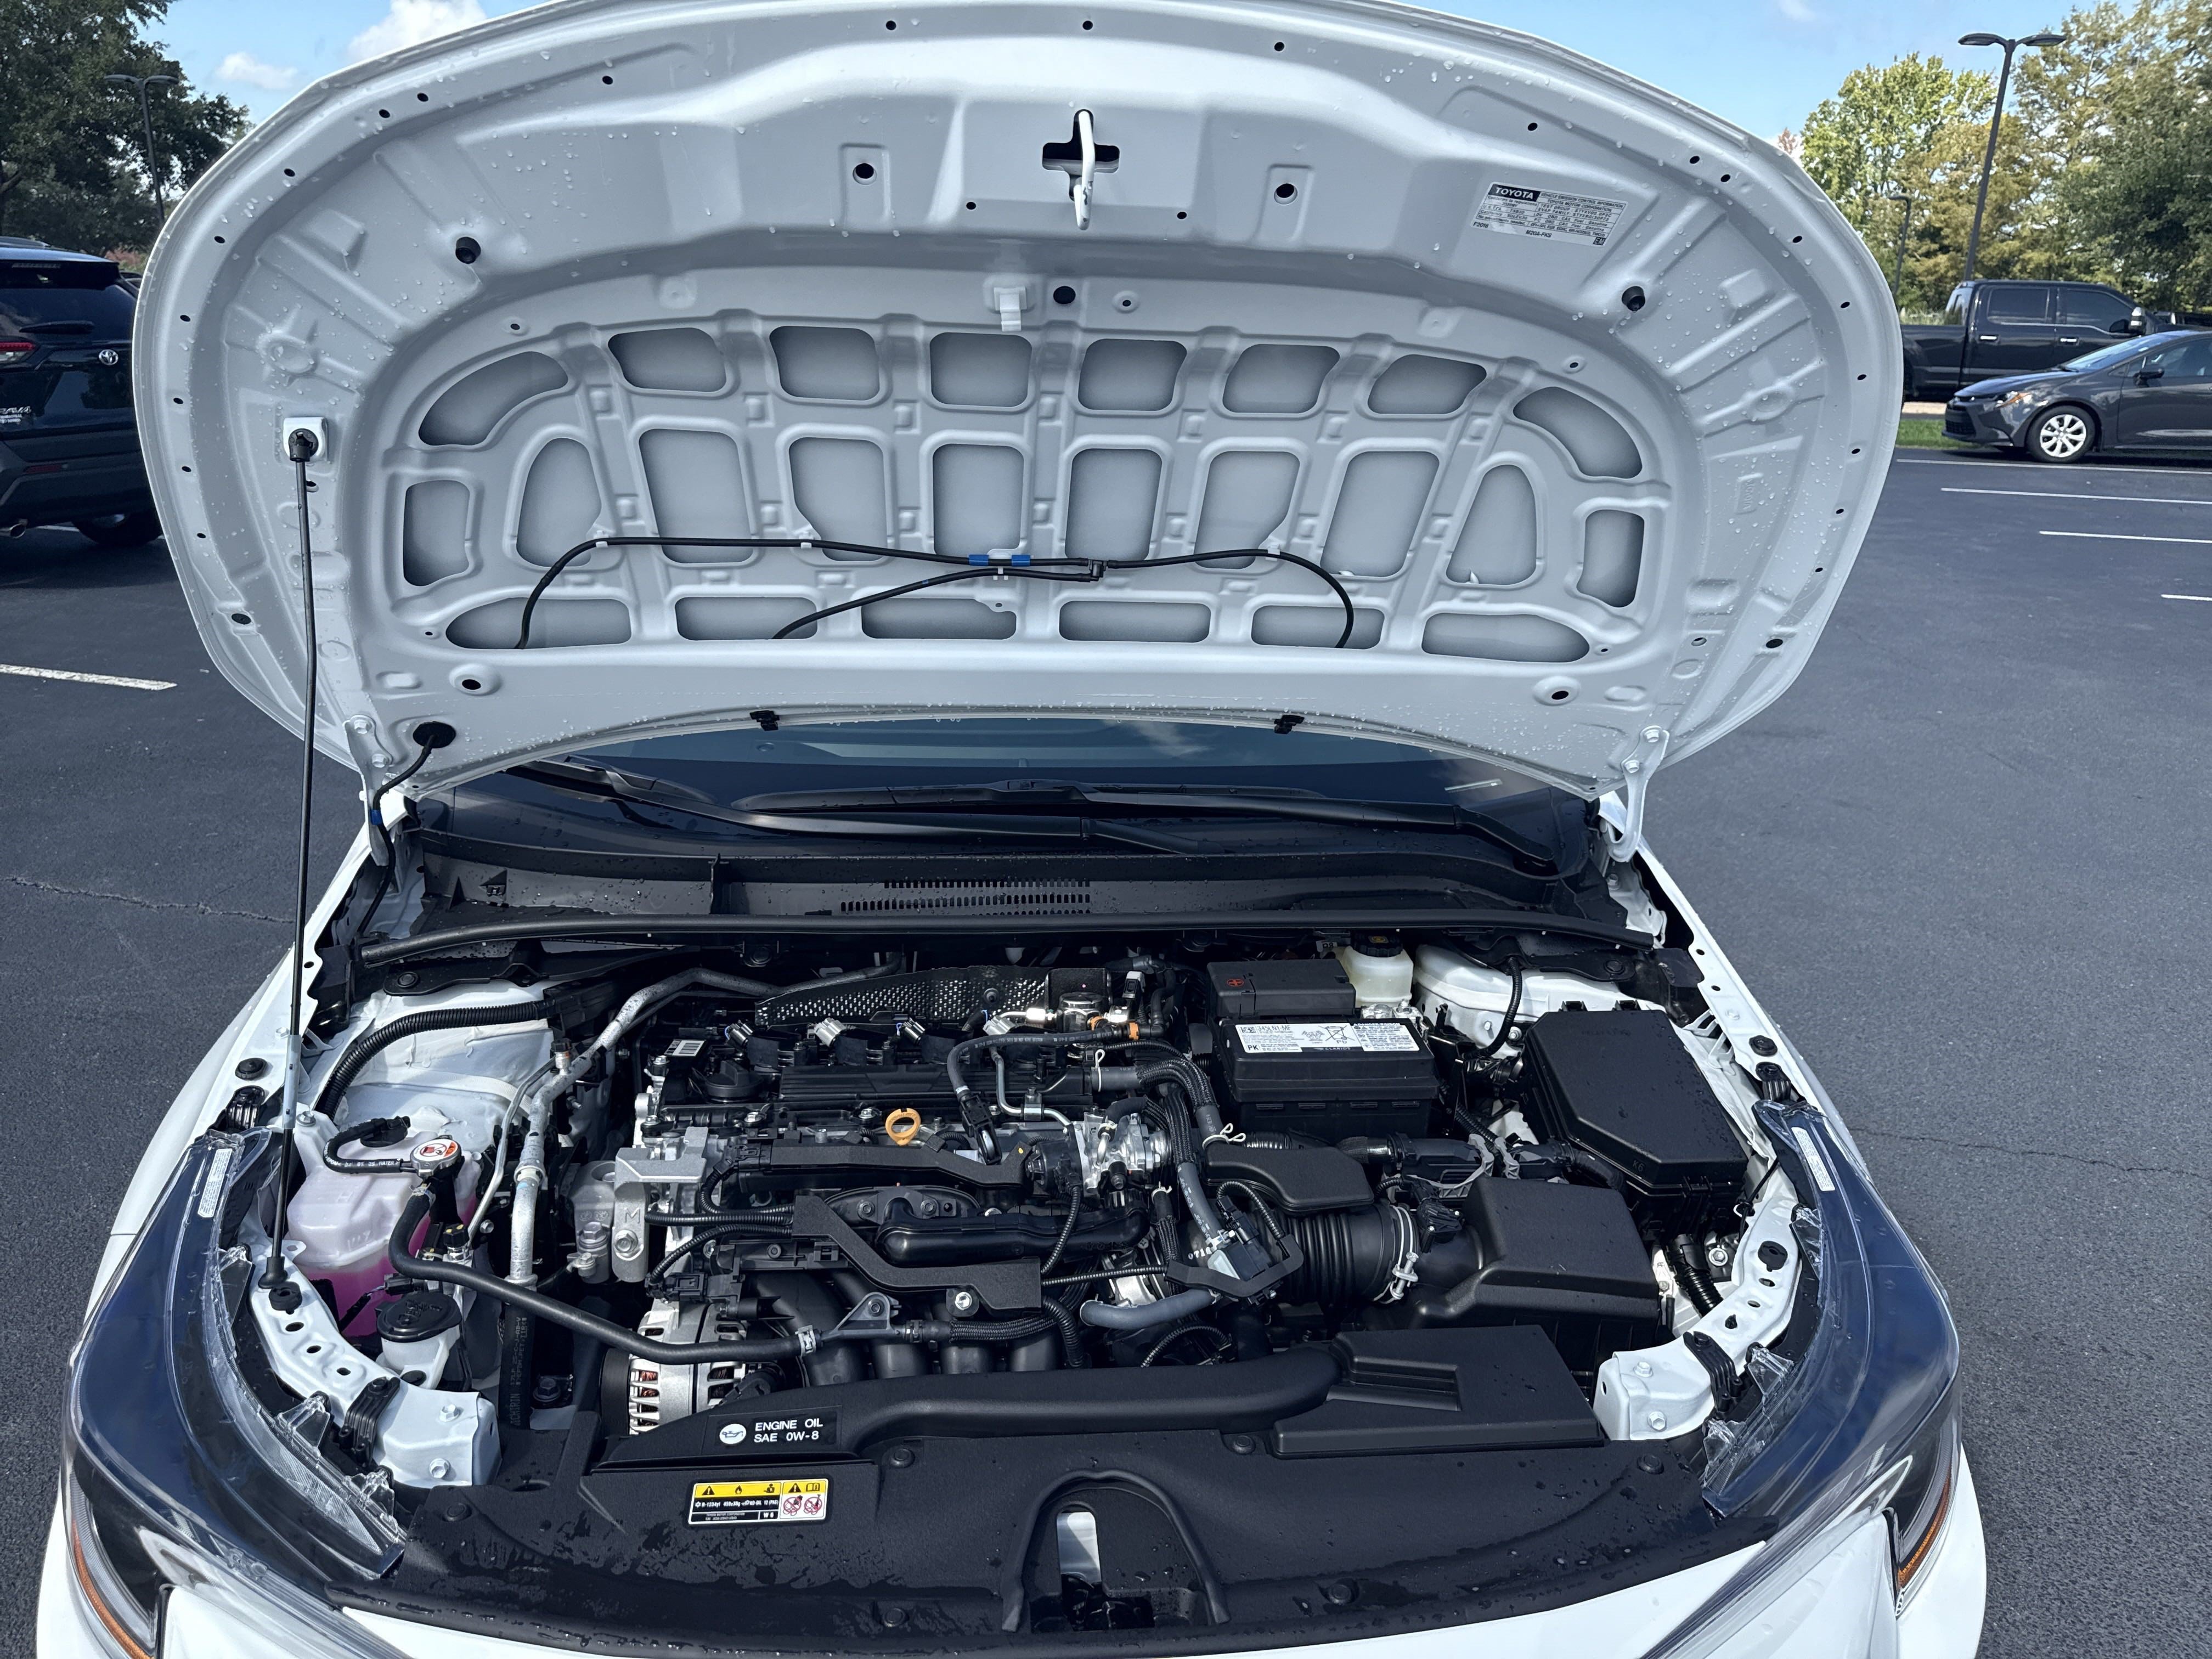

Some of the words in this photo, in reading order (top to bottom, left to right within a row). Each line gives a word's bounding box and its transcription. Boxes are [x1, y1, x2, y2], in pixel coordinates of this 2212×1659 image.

[1496, 187, 1533, 199] TOYOTA
[1581, 204, 1612, 212] CORPORATION
[1526, 229, 1553, 238] M20A-FKS
[1632, 1160, 1645, 1172] K6
[624, 1207, 641, 1224] M
[755, 1420, 797, 1431] ENGINE
[804, 1418, 823, 1428] OIL
[754, 1433, 778, 1443] SAE
[786, 1430, 819, 1441] 0W-8
